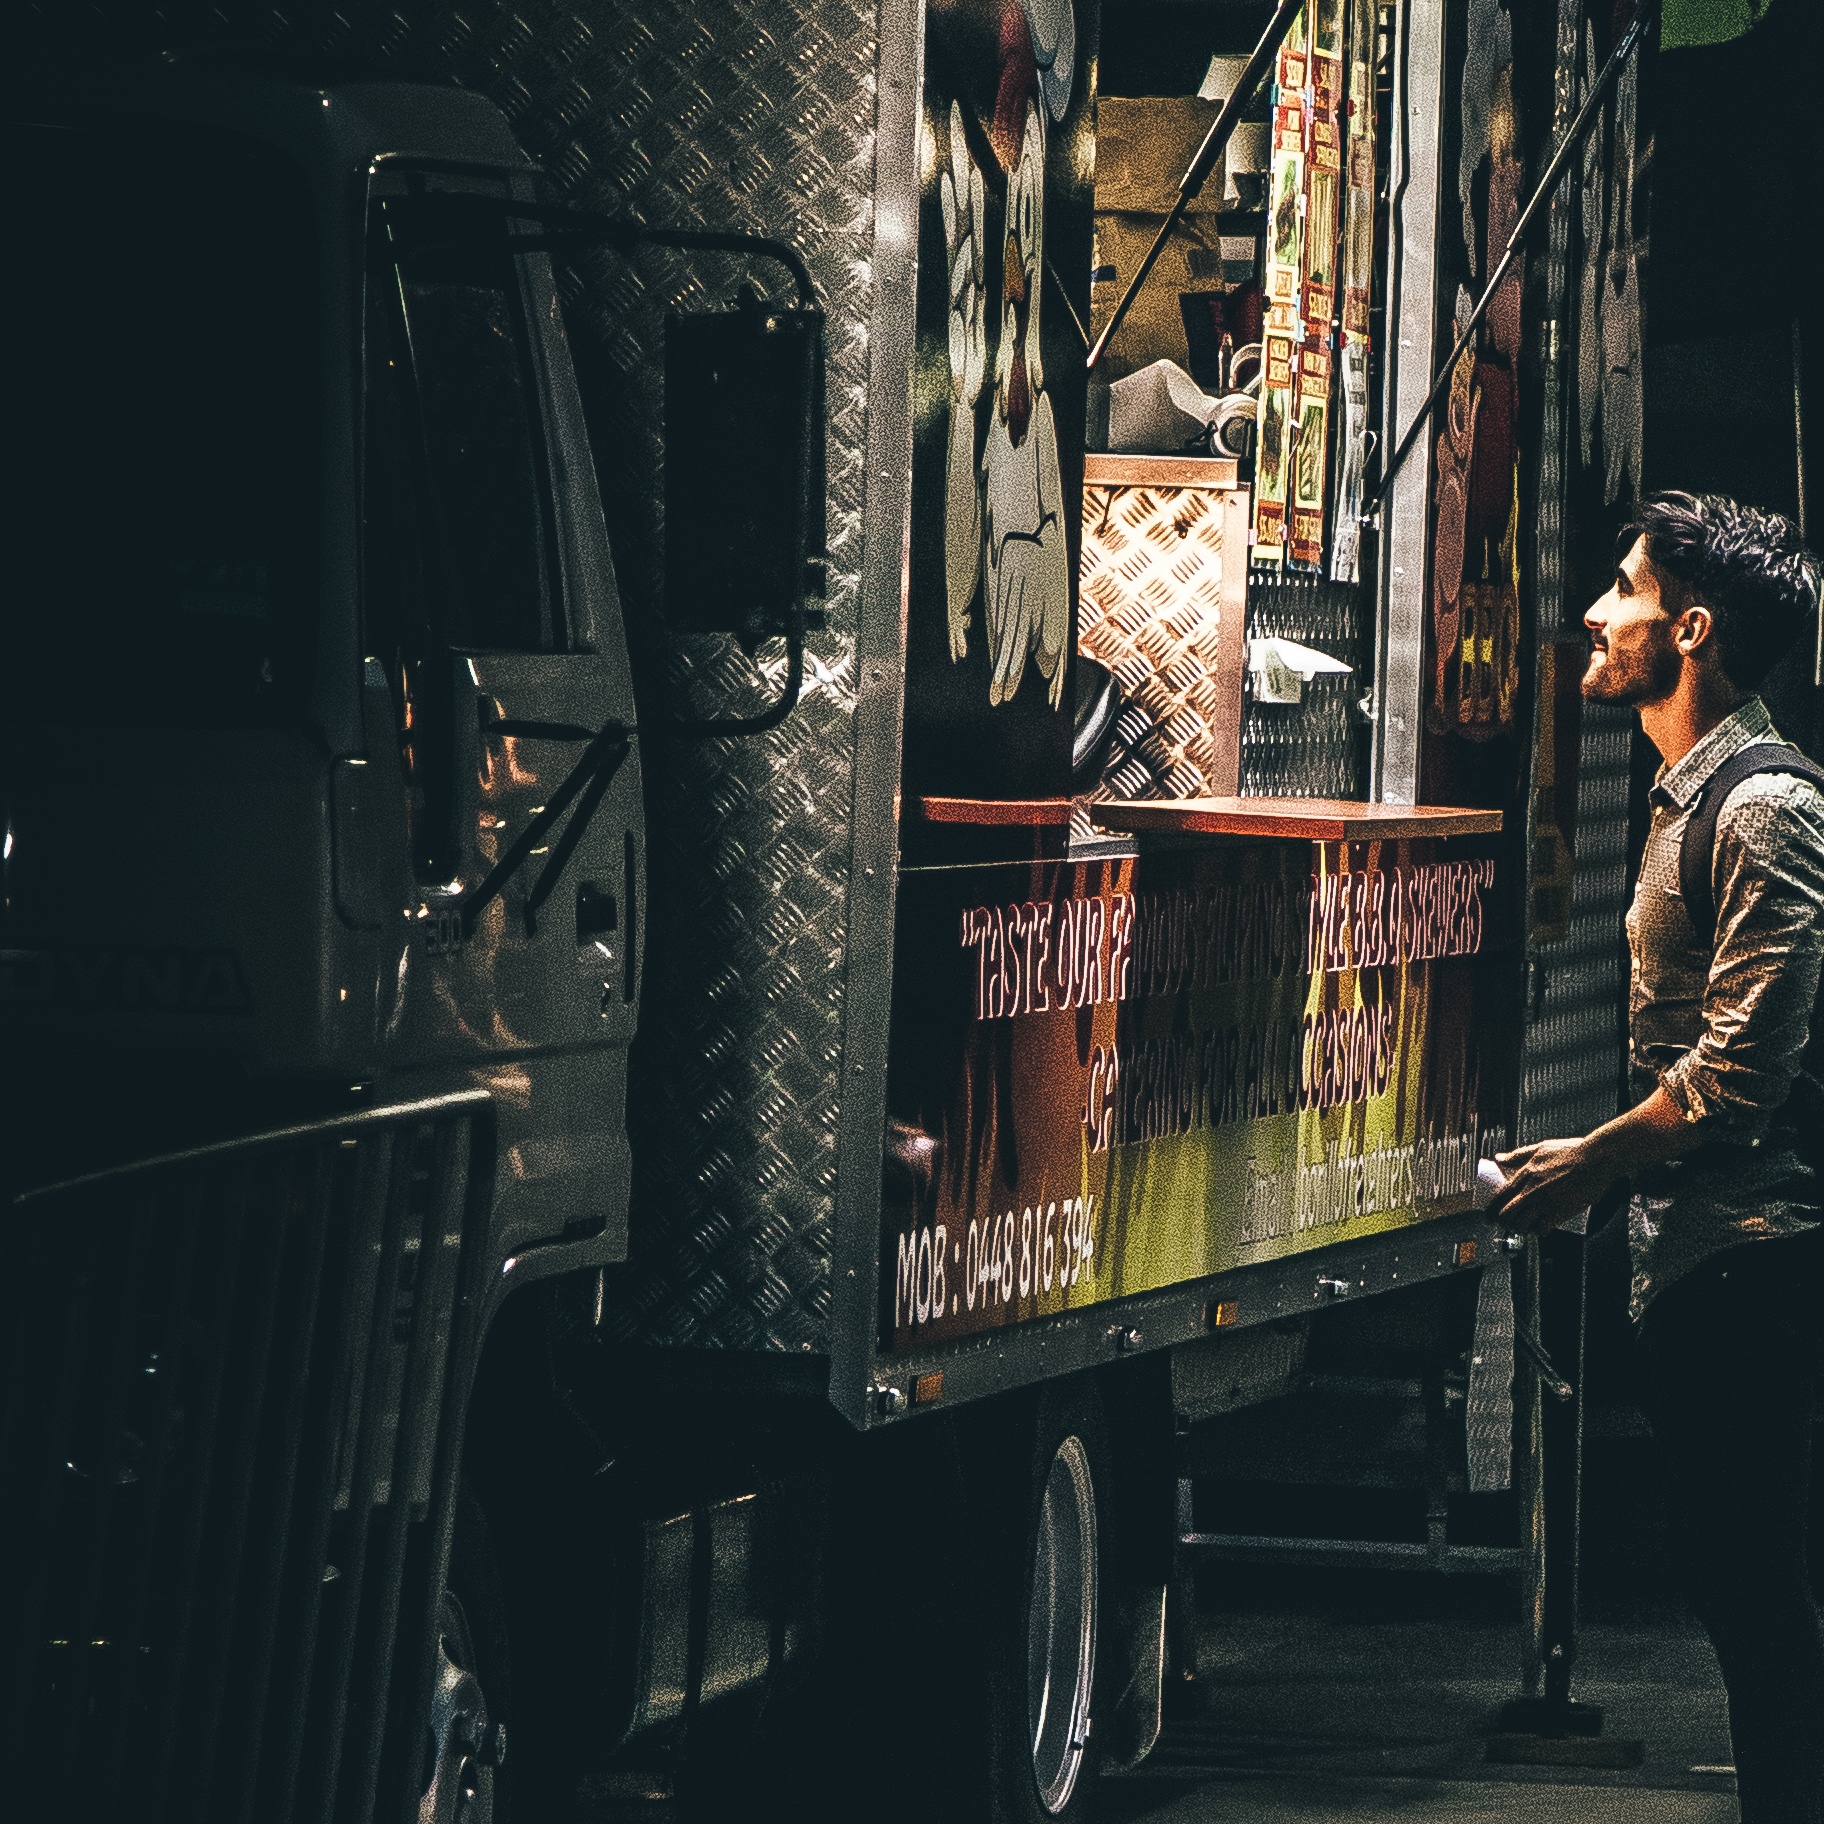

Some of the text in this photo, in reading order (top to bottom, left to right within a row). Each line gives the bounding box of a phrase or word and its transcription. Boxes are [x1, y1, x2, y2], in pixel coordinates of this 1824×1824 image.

[1057, 896, 1105, 1009] OUR
[1197, 1024, 1239, 1128] FOR
[1243, 1019, 1278, 1119] ALL
[965, 1210, 1014, 1311] 0448
[1018, 1201, 1055, 1299] 816
[1059, 1195, 1094, 1288] 394
